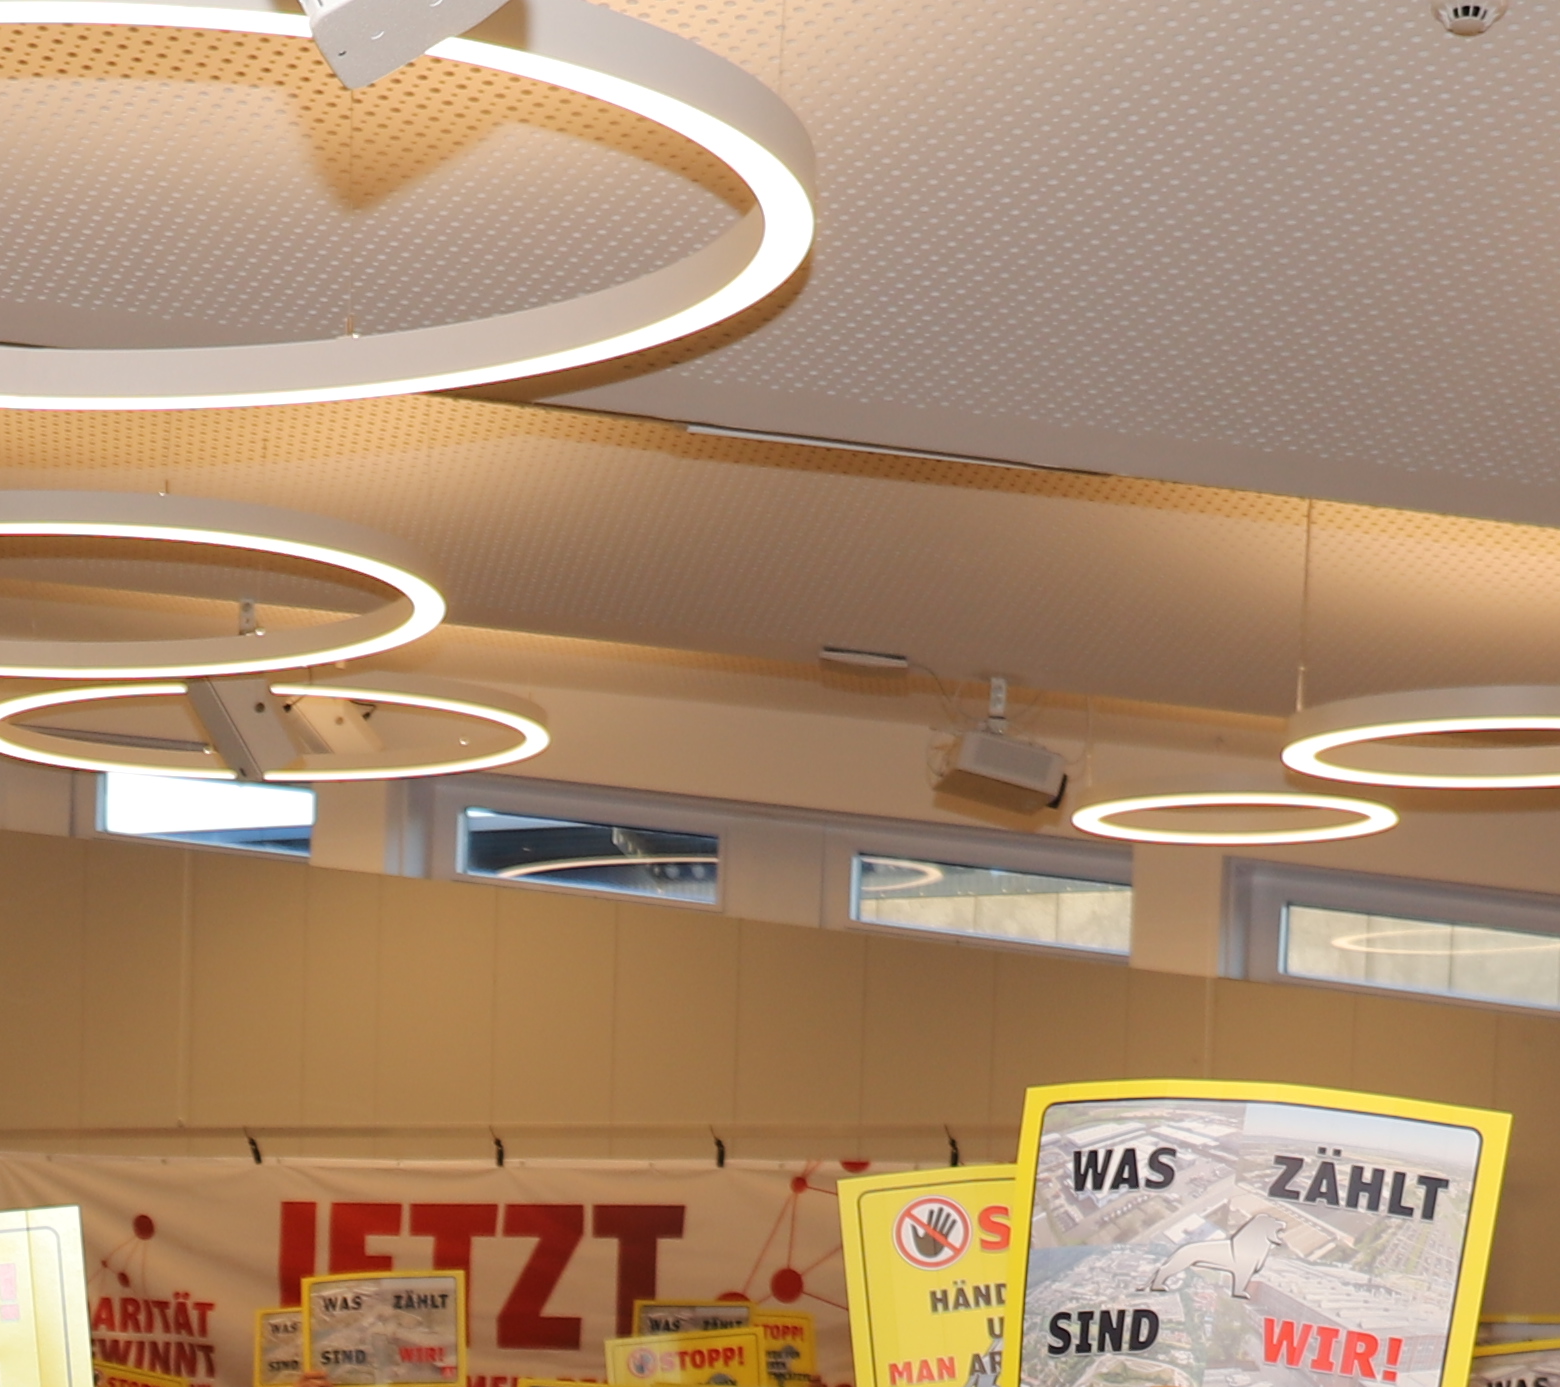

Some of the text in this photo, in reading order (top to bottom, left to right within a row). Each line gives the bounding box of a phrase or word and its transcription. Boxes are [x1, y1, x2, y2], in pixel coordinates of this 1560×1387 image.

[1073, 1147, 1450, 1222] WAS ZÄHLT
[93, 1292, 215, 1338] ARITÄT
[322, 1290, 449, 1312] WAS ZÄHLT
[321, 1346, 446, 1365] SIND WIR!
[659, 1347, 745, 1372] STOPP!
[1047, 1308, 1404, 1383] SIND WIR!
[888, 1356, 957, 1387] MAN
